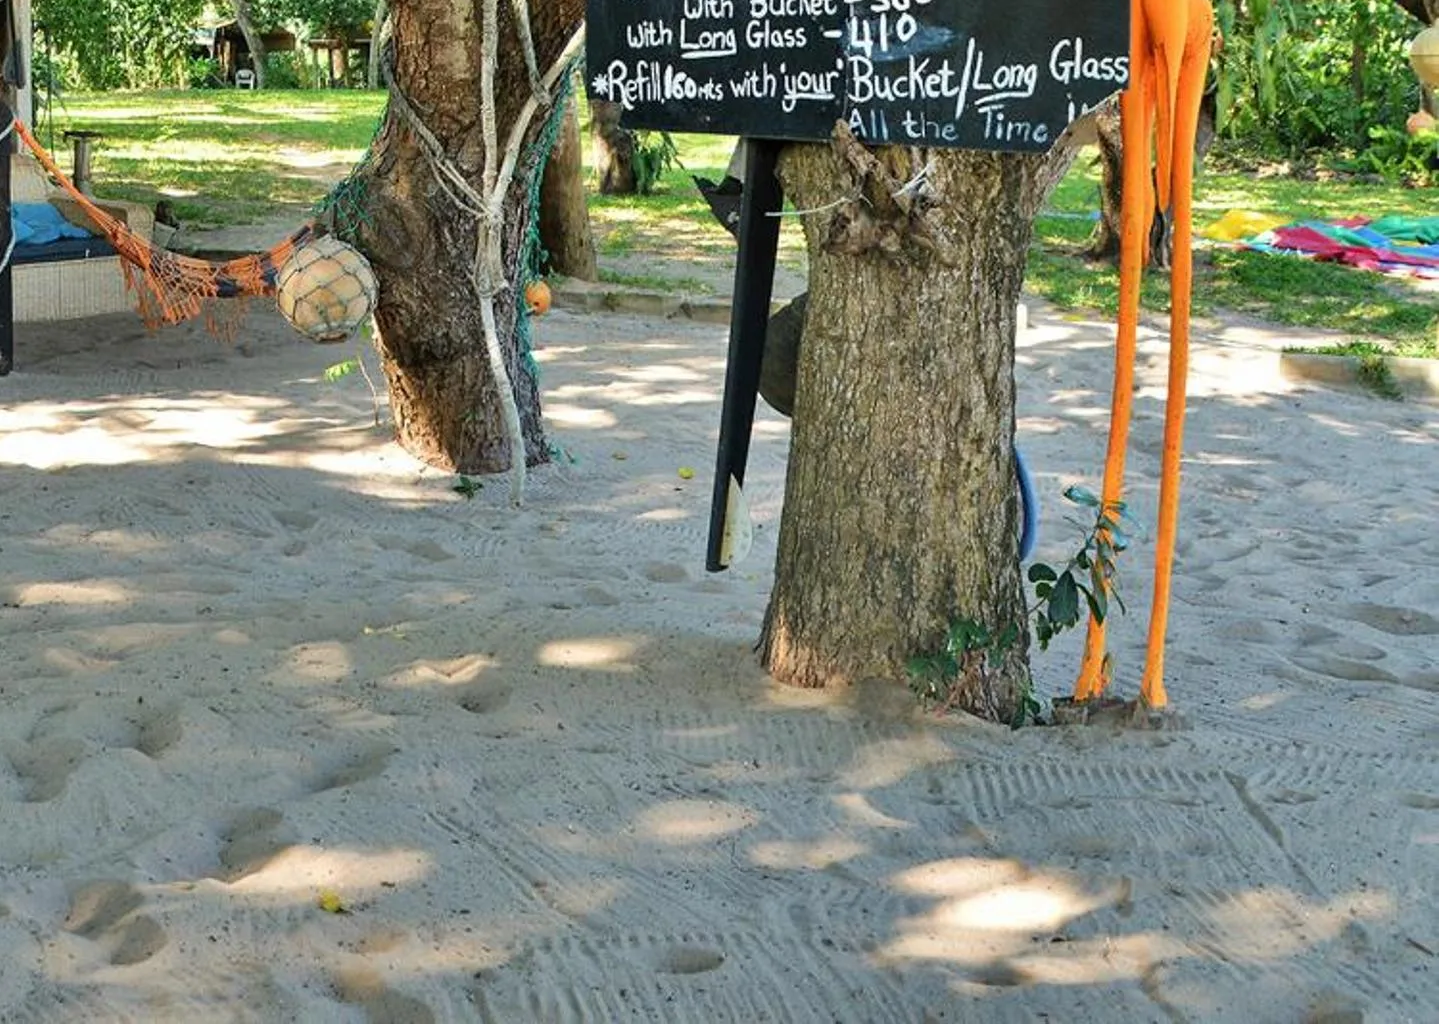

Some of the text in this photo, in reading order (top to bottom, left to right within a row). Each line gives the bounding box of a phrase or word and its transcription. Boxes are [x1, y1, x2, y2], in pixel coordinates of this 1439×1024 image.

[680, 18, 737, 59] Long
[746, 19, 807, 48] Glass
[851, 13, 917, 58] 410
[730, 62, 776, 97] with
[1049, 37, 1128, 83] Glass
[848, 107, 889, 141] All
[902, 109, 959, 141] the
[978, 104, 1048, 142] Time
